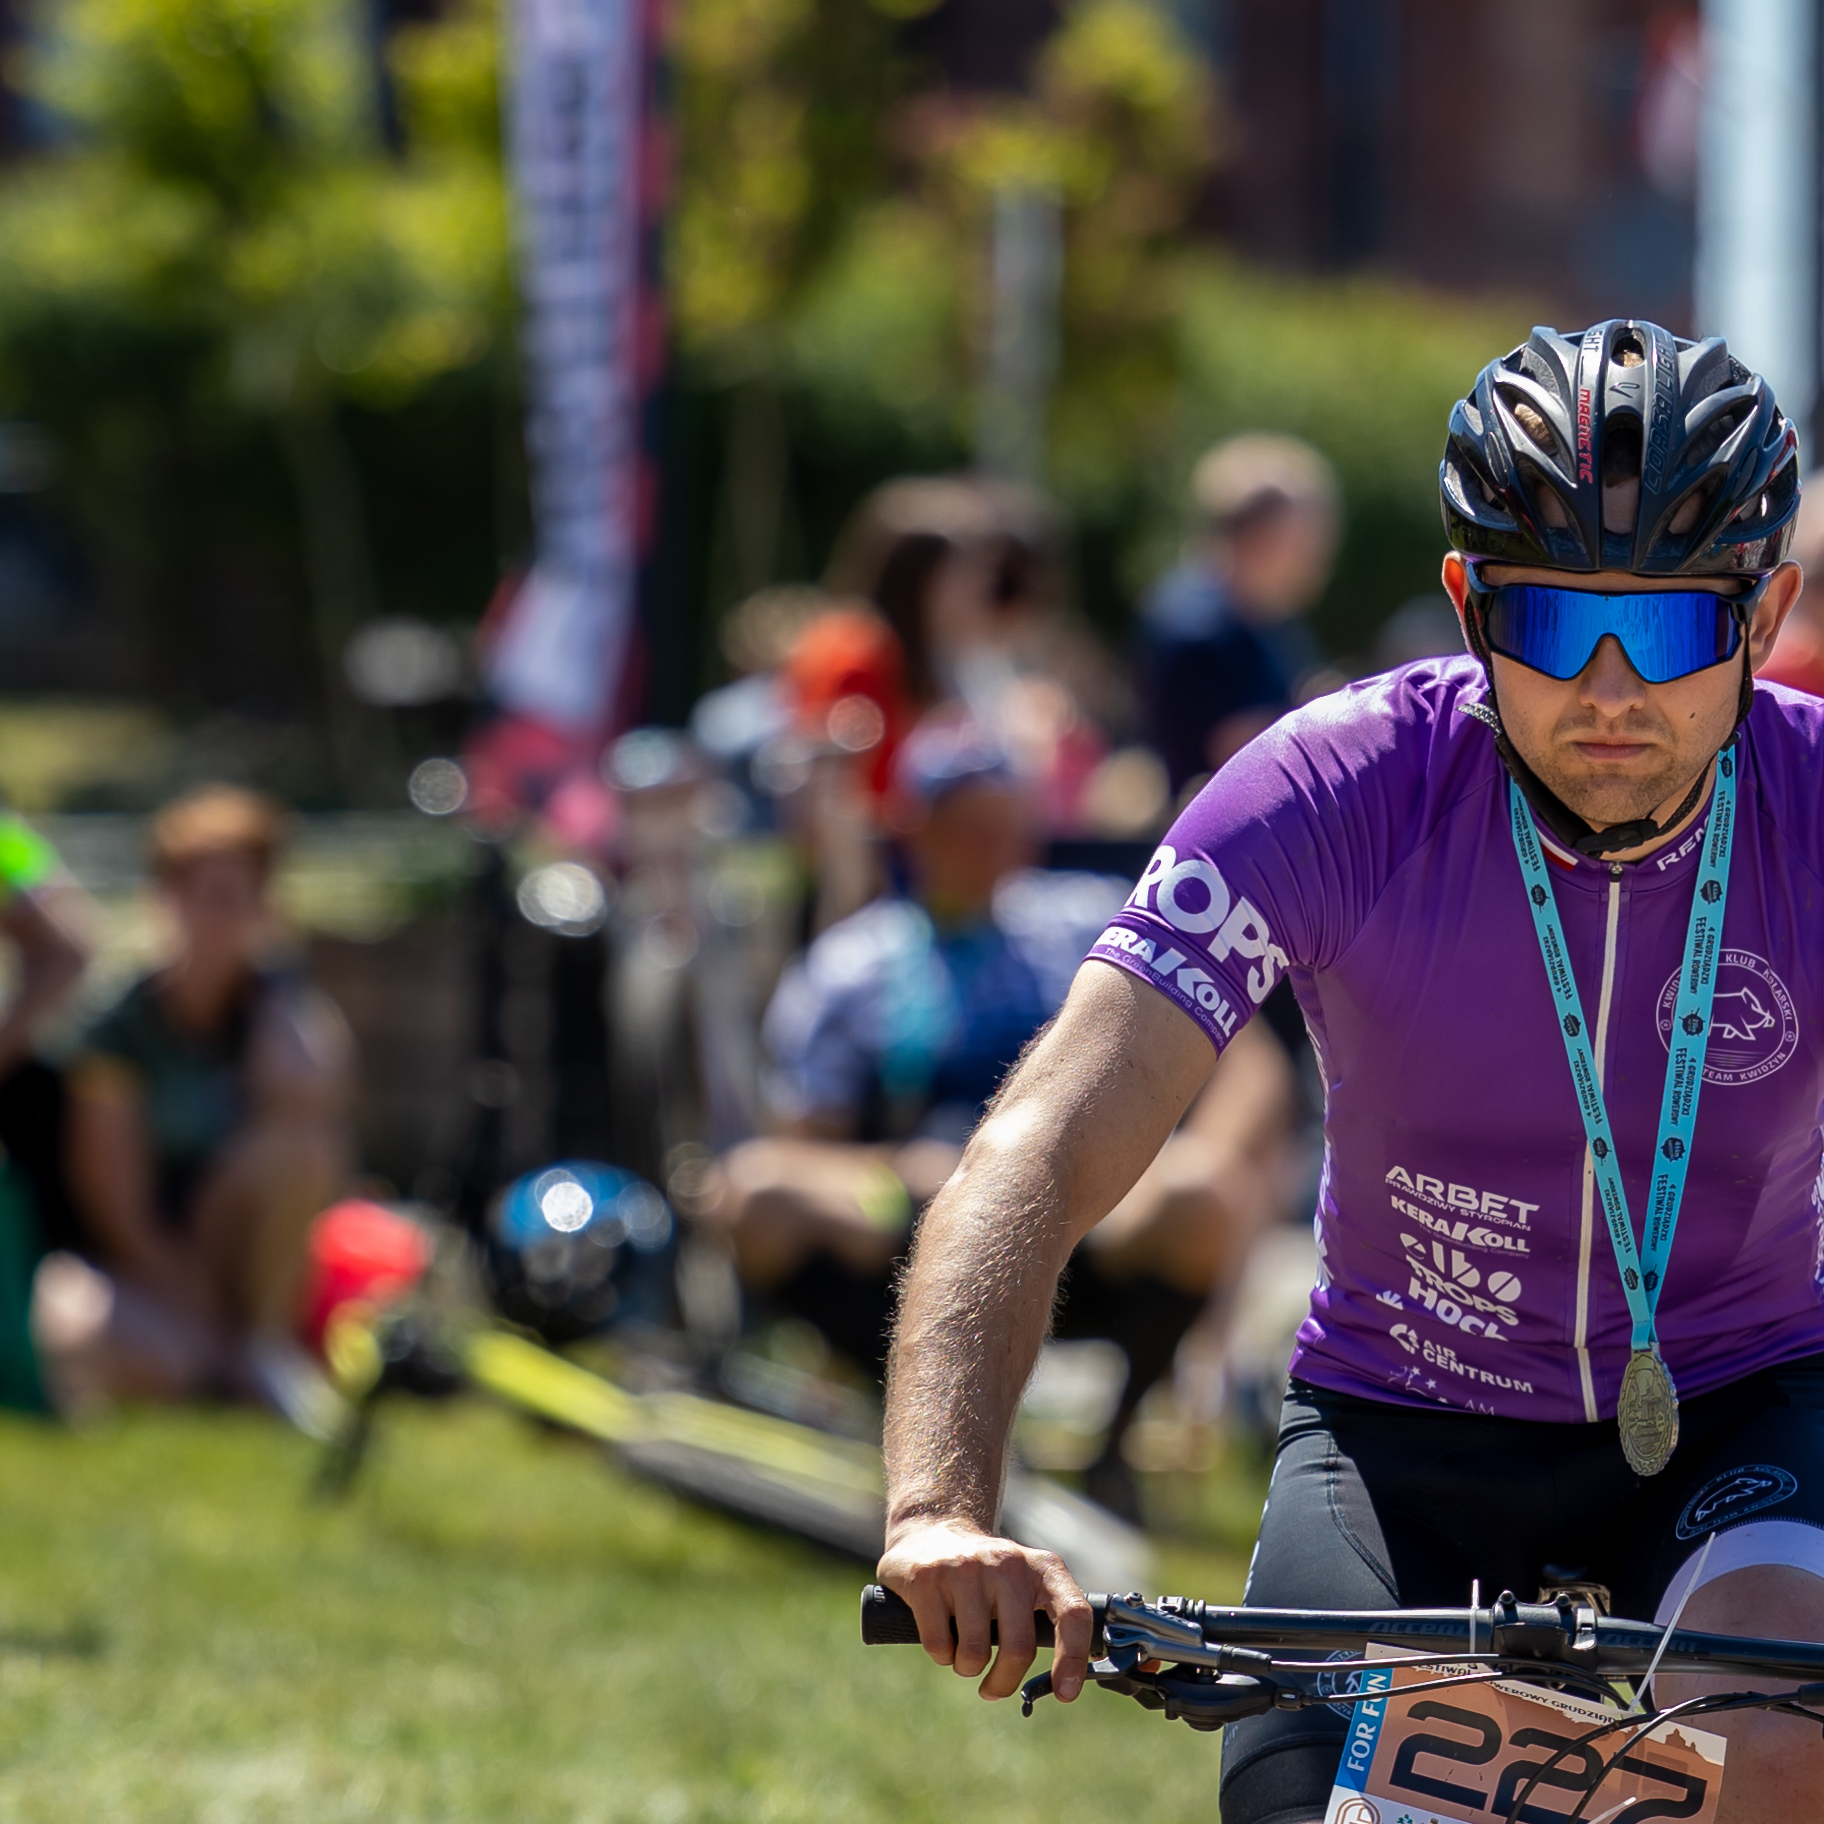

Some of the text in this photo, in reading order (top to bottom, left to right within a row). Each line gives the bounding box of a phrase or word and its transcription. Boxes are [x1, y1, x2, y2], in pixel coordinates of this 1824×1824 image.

[1694, 917, 1707, 958] FESTIWAL
[1104, 947, 1225, 1047] The GreenBuilding Company
[1726, 954, 1756, 968] KLUB
[1763, 969, 1793, 1020] KOLARSKI
[1675, 1048, 1687, 1093] FESTIWAL
[1703, 1052, 1786, 1081] TEAM KWIDZYN
[1385, 1165, 1540, 1224] ARBET
[1385, 1178, 1531, 1231] PRAWDZIWY STYROPIAN
[1656, 1173, 1669, 1217] FESTIWAL
[1405, 1254, 1519, 1326] TROPS
[1423, 1339, 1457, 1361] AIR
[1423, 1349, 1534, 1394] CENTRUM
[1347, 1721, 1376, 1772] FOR
